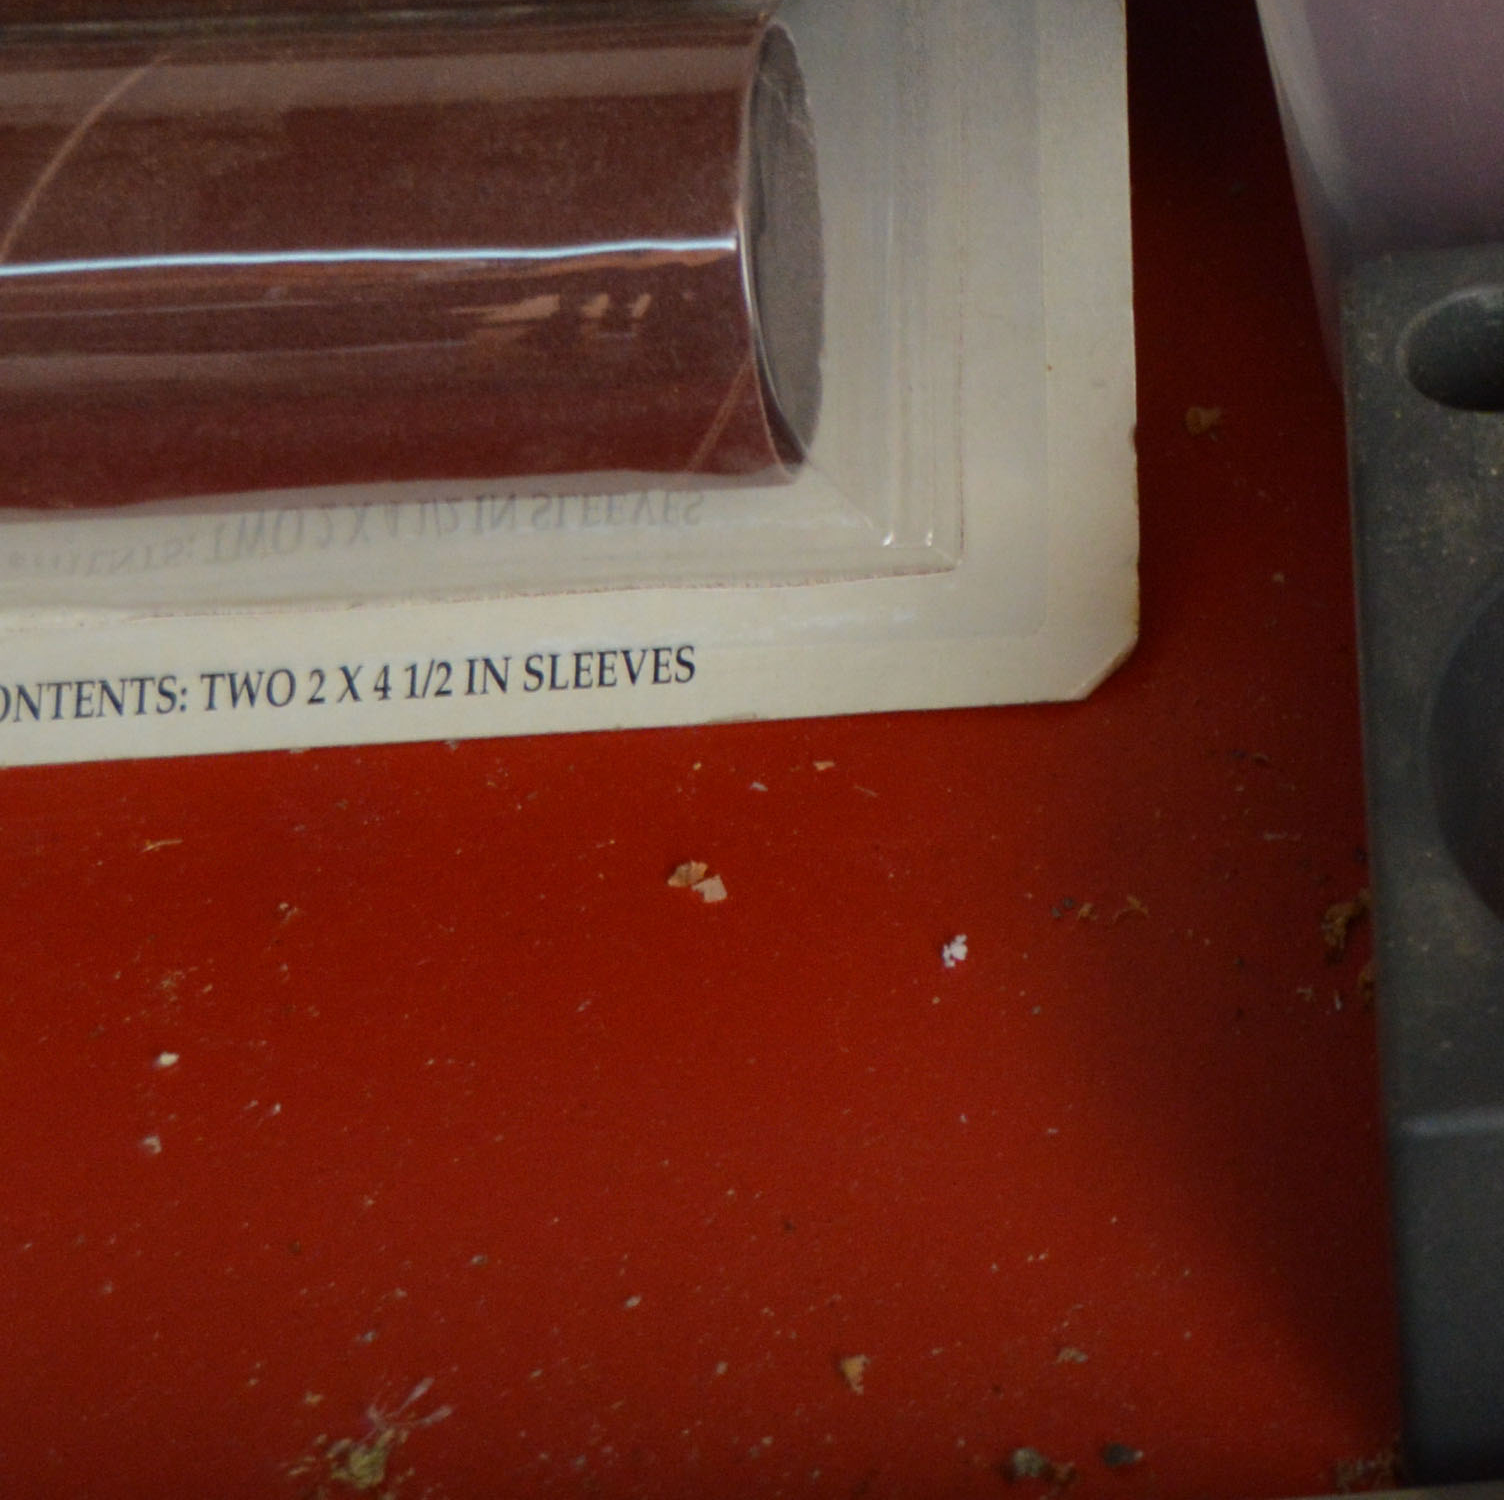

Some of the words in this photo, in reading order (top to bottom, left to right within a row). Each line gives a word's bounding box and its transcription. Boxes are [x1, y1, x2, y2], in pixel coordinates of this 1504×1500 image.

[199, 667, 297, 712] TWO
[307, 668, 327, 705] 2
[337, 665, 364, 703] X
[373, 663, 393, 700] 4
[404, 658, 453, 699] 1/2
[464, 655, 512, 696] IN
[523, 644, 697, 693] SLEEVES
